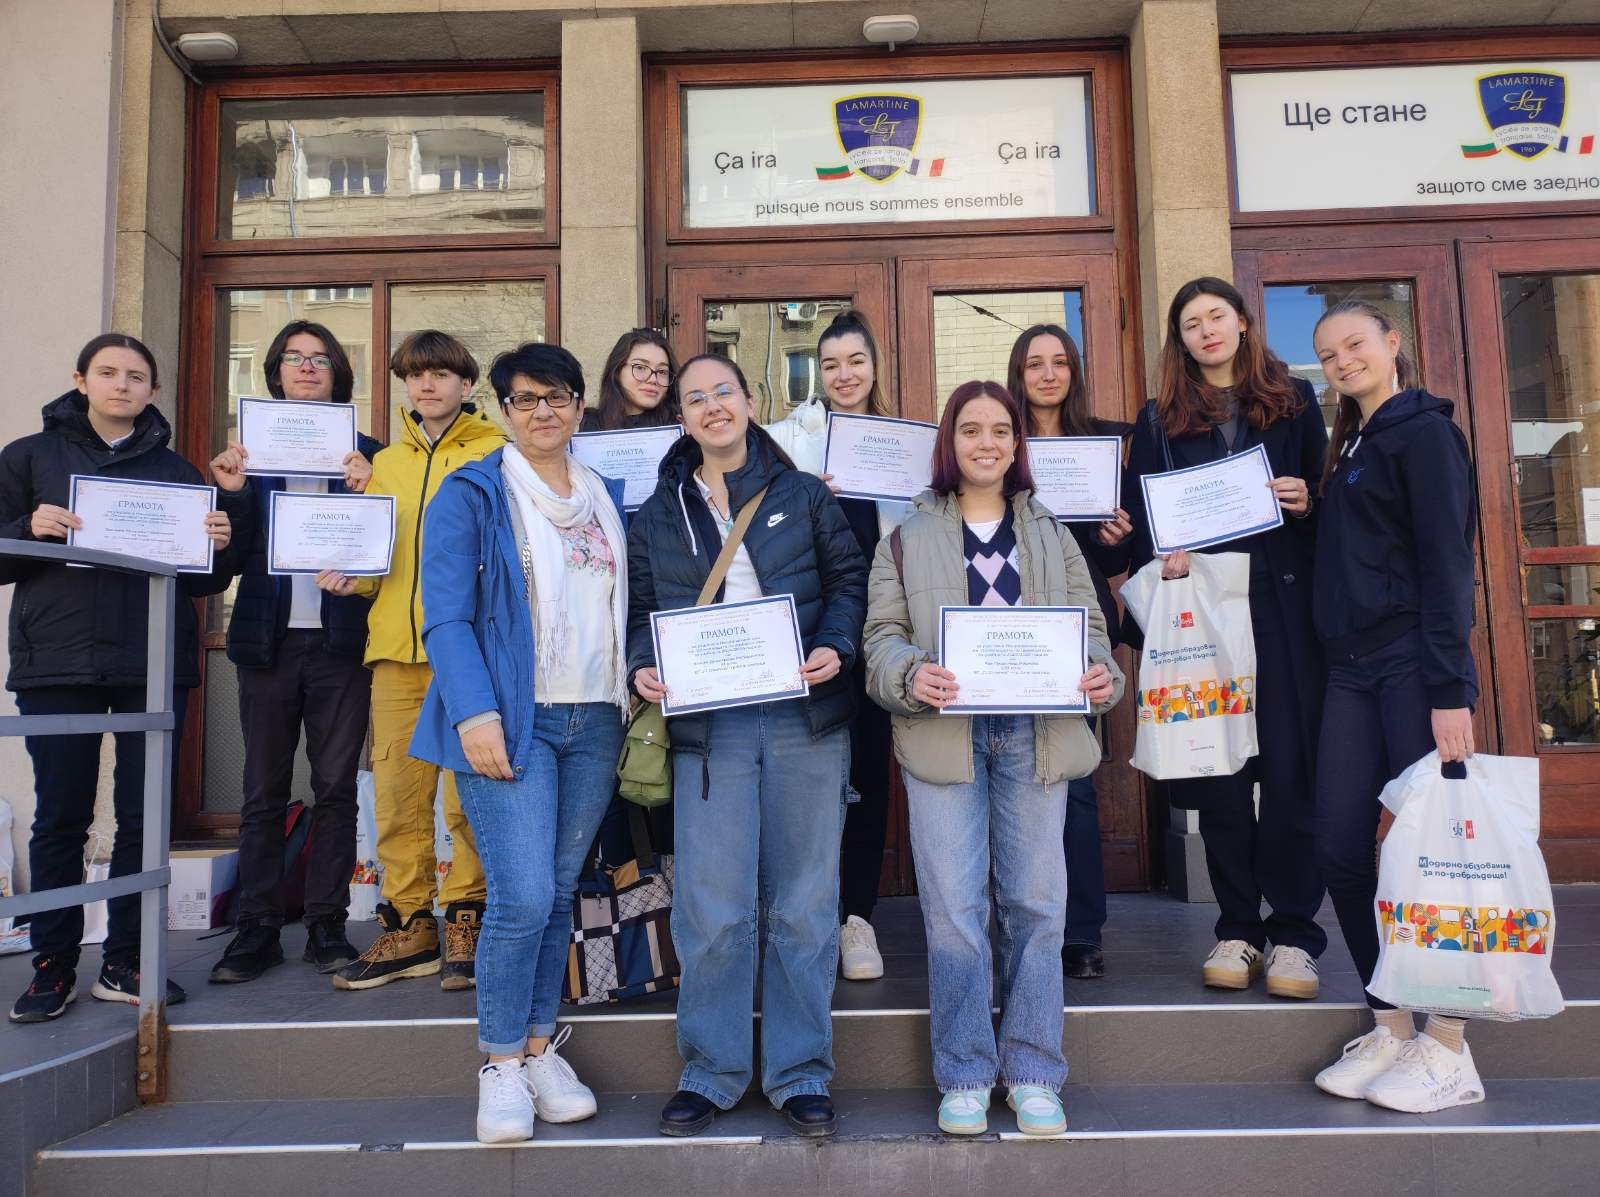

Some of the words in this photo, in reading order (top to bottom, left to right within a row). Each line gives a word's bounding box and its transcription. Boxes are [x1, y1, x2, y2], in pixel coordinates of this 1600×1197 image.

[1488, 76, 1556, 89] LAMARTINE
[845, 100, 910, 112] LAMARTINE
[1283, 102, 1331, 131] Ще
[1341, 103, 1427, 125] стане
[997, 142, 1028, 166] Ça
[1034, 141, 1061, 160] ira
[714, 150, 744, 175] Ça
[750, 150, 777, 170] ira
[1415, 178, 1486, 196] защото
[1491, 178, 1528, 192] сме
[1533, 176, 1600, 192] заедно
[755, 199, 820, 218] puisque
[824, 198, 865, 213] nous
[869, 196, 940, 212] sommes
[944, 192, 1024, 209] ensemble
[277, 417, 316, 426] ГРАМОТА
[863, 435, 900, 446] ГРАМОТА
[606, 447, 645, 457] ГРАМОТА
[1038, 457, 1077, 465] ГРАМОТА
[1184, 479, 1226, 495] ГРАМОТА
[118, 500, 164, 511] ГРАМОТА
[311, 513, 351, 521] ГРАМОТА
[700, 625, 747, 640] ГРАМОТА
[986, 631, 1034, 640] ГРАМОТА
[1418, 856, 1463, 869] Модерно
